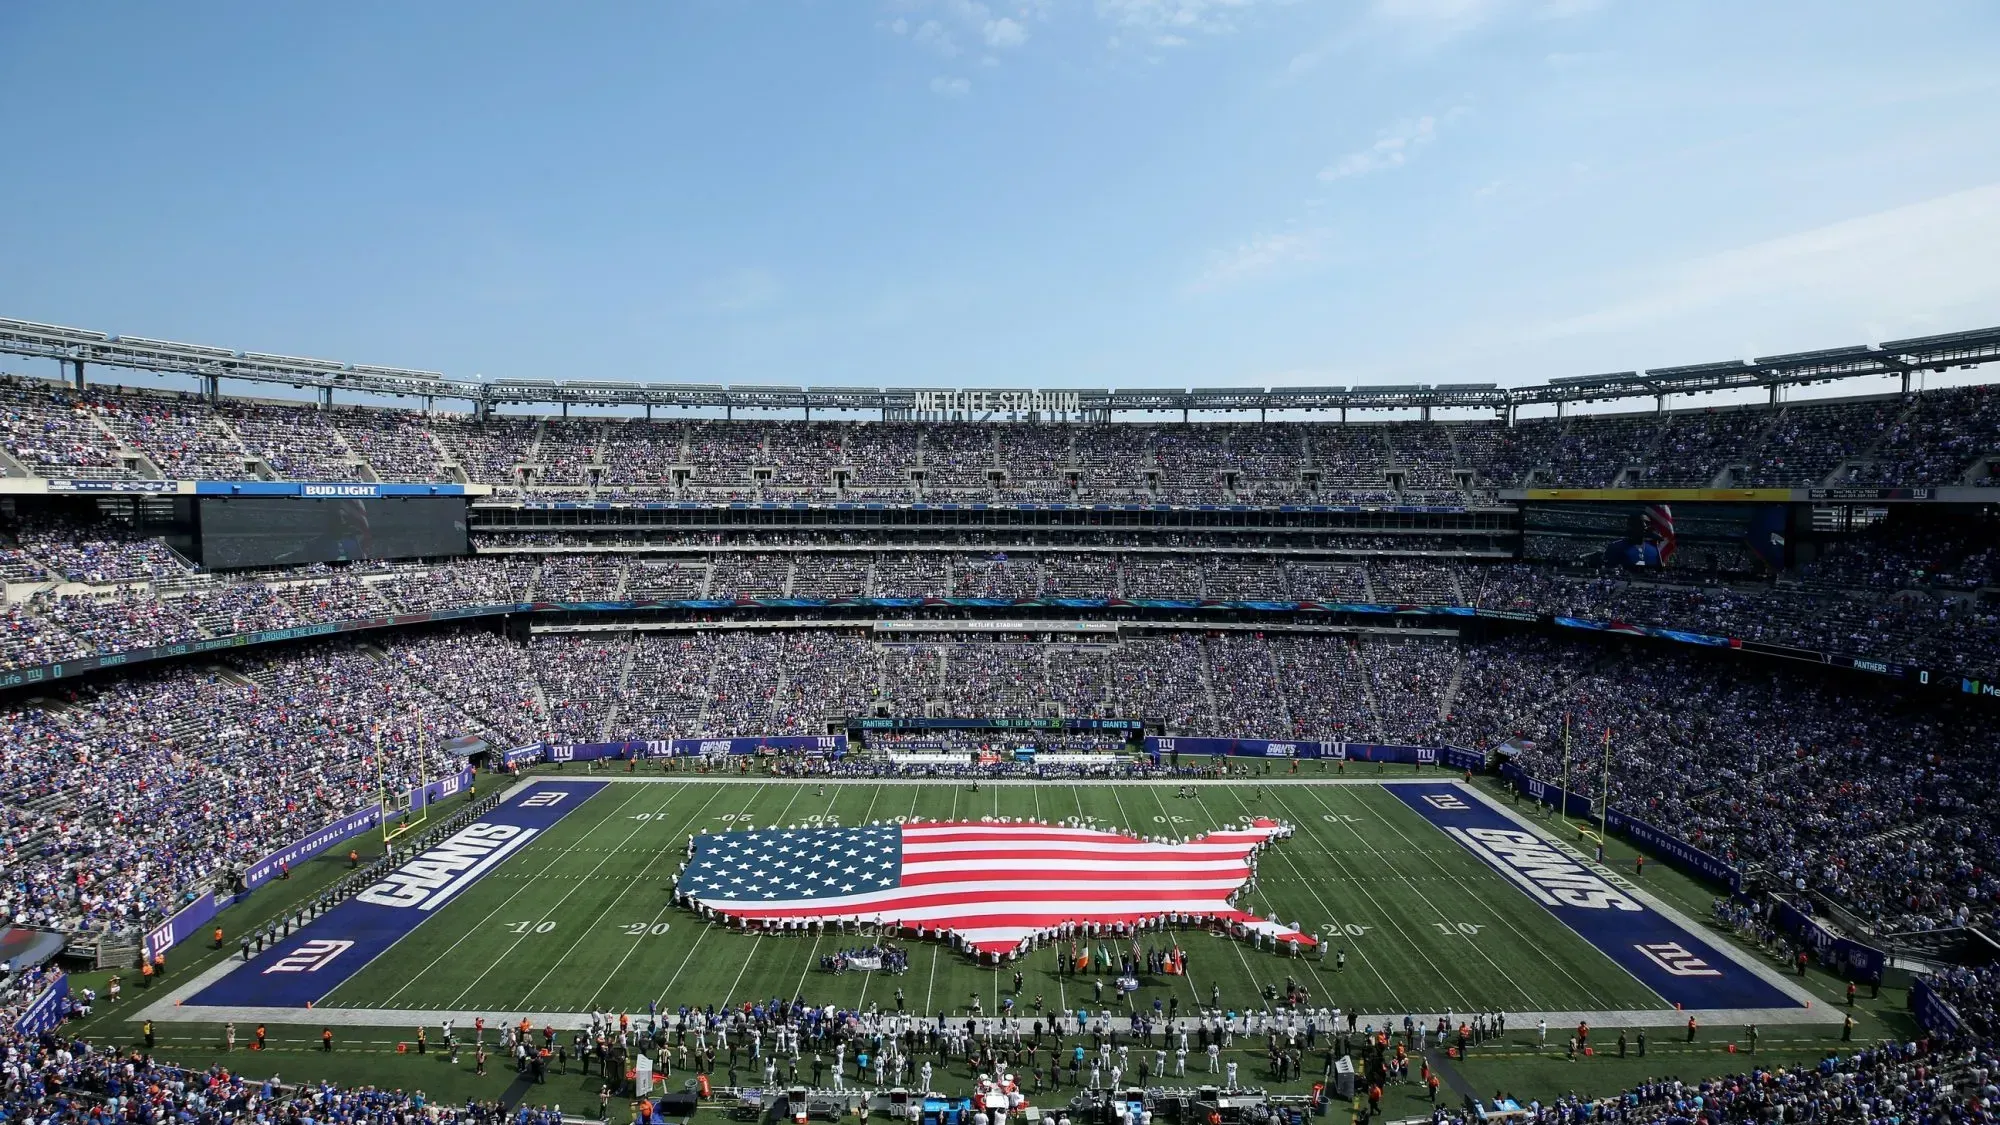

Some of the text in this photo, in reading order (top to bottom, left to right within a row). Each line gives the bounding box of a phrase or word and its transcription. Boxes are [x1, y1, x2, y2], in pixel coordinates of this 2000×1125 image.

[915, 392, 1079, 412] METLIFE STADIUM
[306, 486, 376, 495] BUD LIGHT
[206, 640, 231, 650] QUARTER
[235, 638, 244, 646] 25
[260, 632, 290, 642] AROUND
[293, 629, 306, 638] THE
[308, 624, 336, 636] LEAGUE
[100, 655, 126, 666] GIANTS
[1854, 660, 1886, 672] PANTHERS
[53, 664, 62, 678] 0
[1920, 671, 1928, 684] 0
[646, 740, 672, 757] ny
[700, 740, 731, 751] GIANTS
[817, 737, 835, 749] ny
[1158, 739, 1174, 752] ny
[1267, 744, 1296, 754] GIANTS
[553, 746, 573, 761] ny
[1319, 742, 1346, 759] ny
[1417, 749, 1435, 762] ny
[443, 776, 459, 796] ny
[1529, 780, 1544, 798] ny
[636, 812, 670, 821] 10
[721, 813, 756, 822] 20
[1154, 815, 1186, 824] 30
[1323, 814, 1357, 822] 10
[1547, 840, 1578, 854] END
[1608, 816, 1622, 825] NE
[1630, 826, 1652, 840] YORK
[1656, 838, 1700, 865] FOOTBALL
[252, 866, 270, 882] NEW
[273, 850, 297, 870] YORK
[301, 828, 344, 854] FOOTBALL
[356, 822, 521, 908] GIANTS
[1465, 828, 1644, 912] GIANTS
[510, 920, 557, 934] 10
[626, 922, 671, 936] 20
[1322, 923, 1364, 936] 20
[1433, 923, 1478, 935] 10
[153, 922, 174, 956] ny
[262, 940, 354, 974] ny
[1634, 942, 1722, 976] ny
